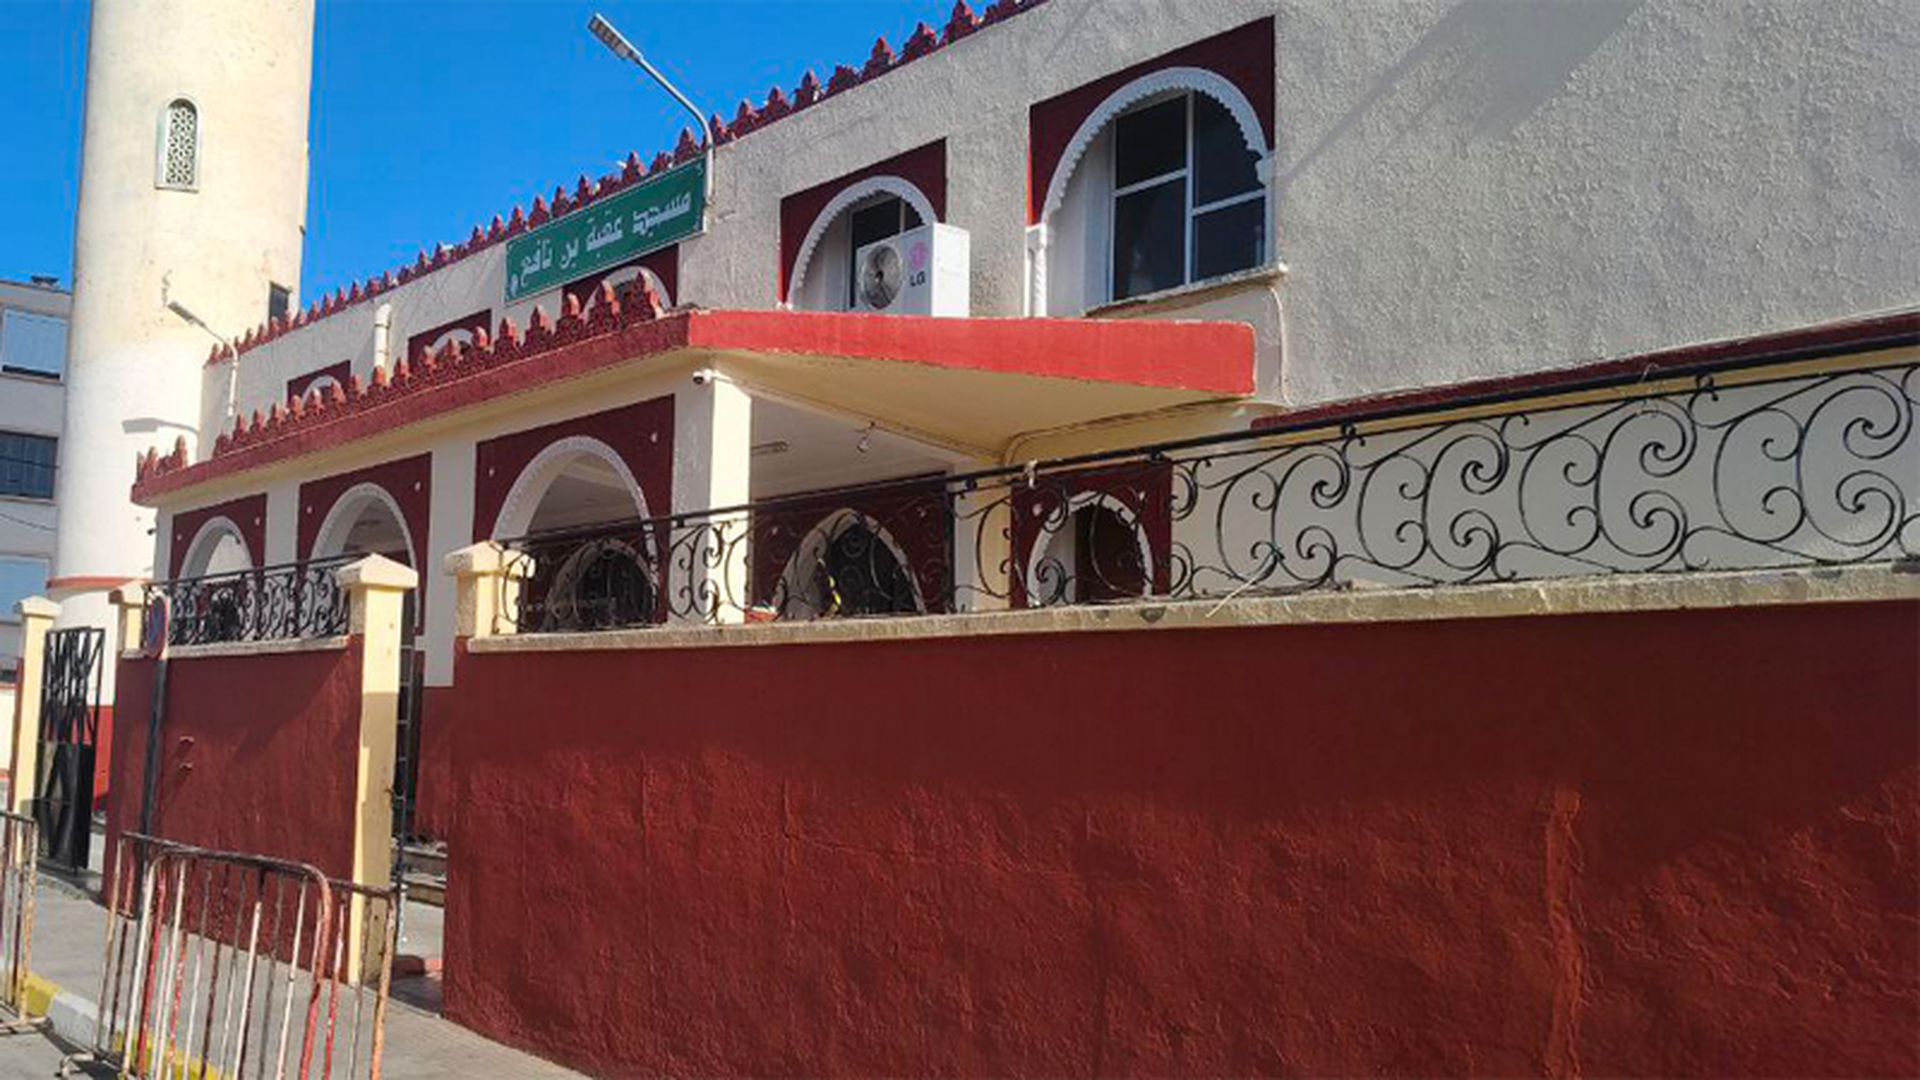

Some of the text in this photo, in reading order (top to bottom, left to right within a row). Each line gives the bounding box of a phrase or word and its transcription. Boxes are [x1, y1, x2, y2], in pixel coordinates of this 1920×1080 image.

[586, 210, 623, 258] عقبة
[632, 192, 691, 237] مسجد
[520, 238, 552, 288] نافع
[560, 239, 579, 269] بن
[909, 270, 925, 287] LG
